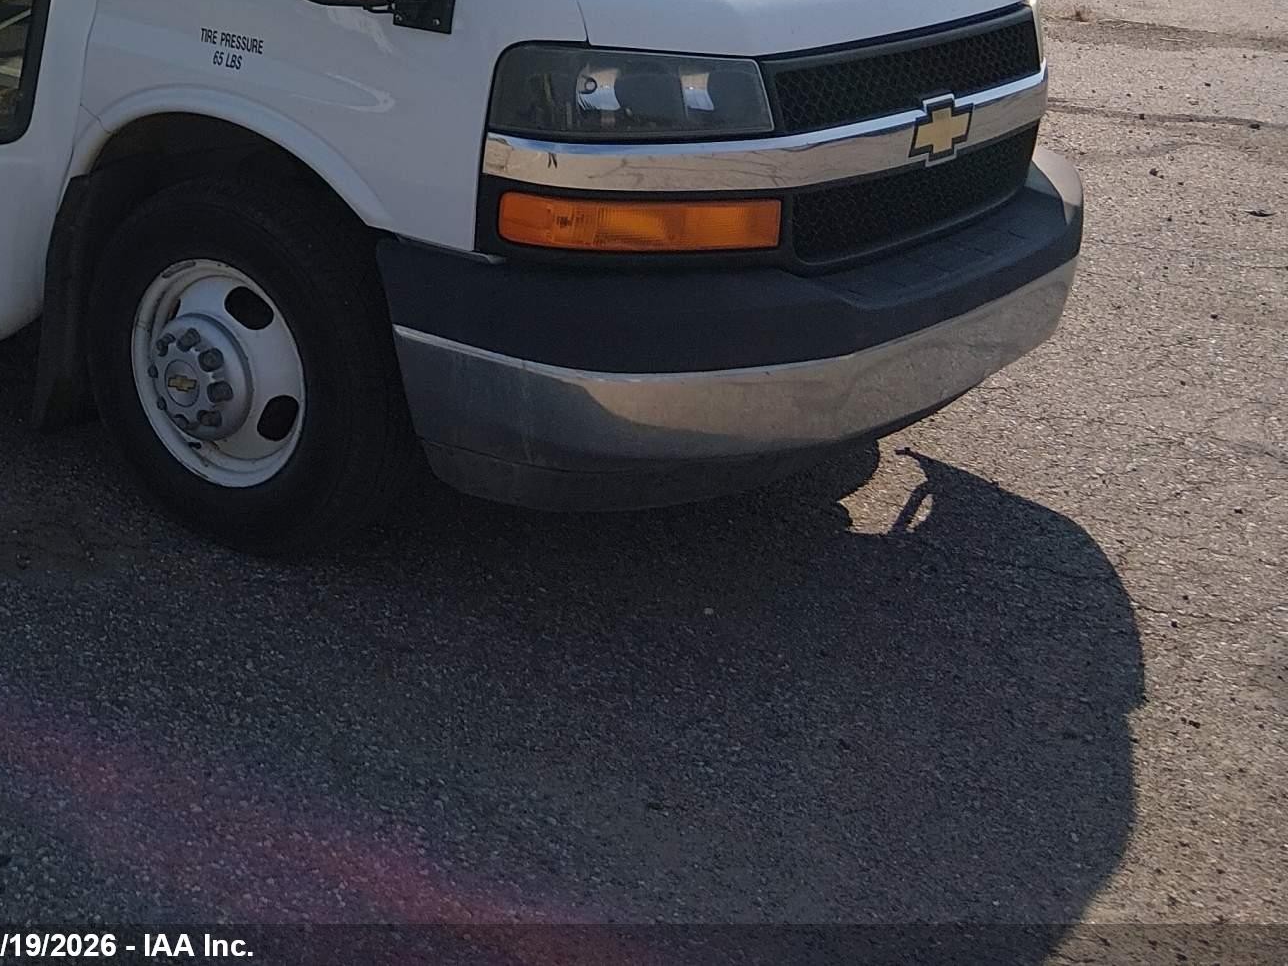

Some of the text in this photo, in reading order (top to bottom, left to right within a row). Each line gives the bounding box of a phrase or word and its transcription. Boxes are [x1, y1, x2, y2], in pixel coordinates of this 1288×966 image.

[201, 28, 264, 54] TIRE PRESSURE
[213, 50, 242, 70] 65 LBS
